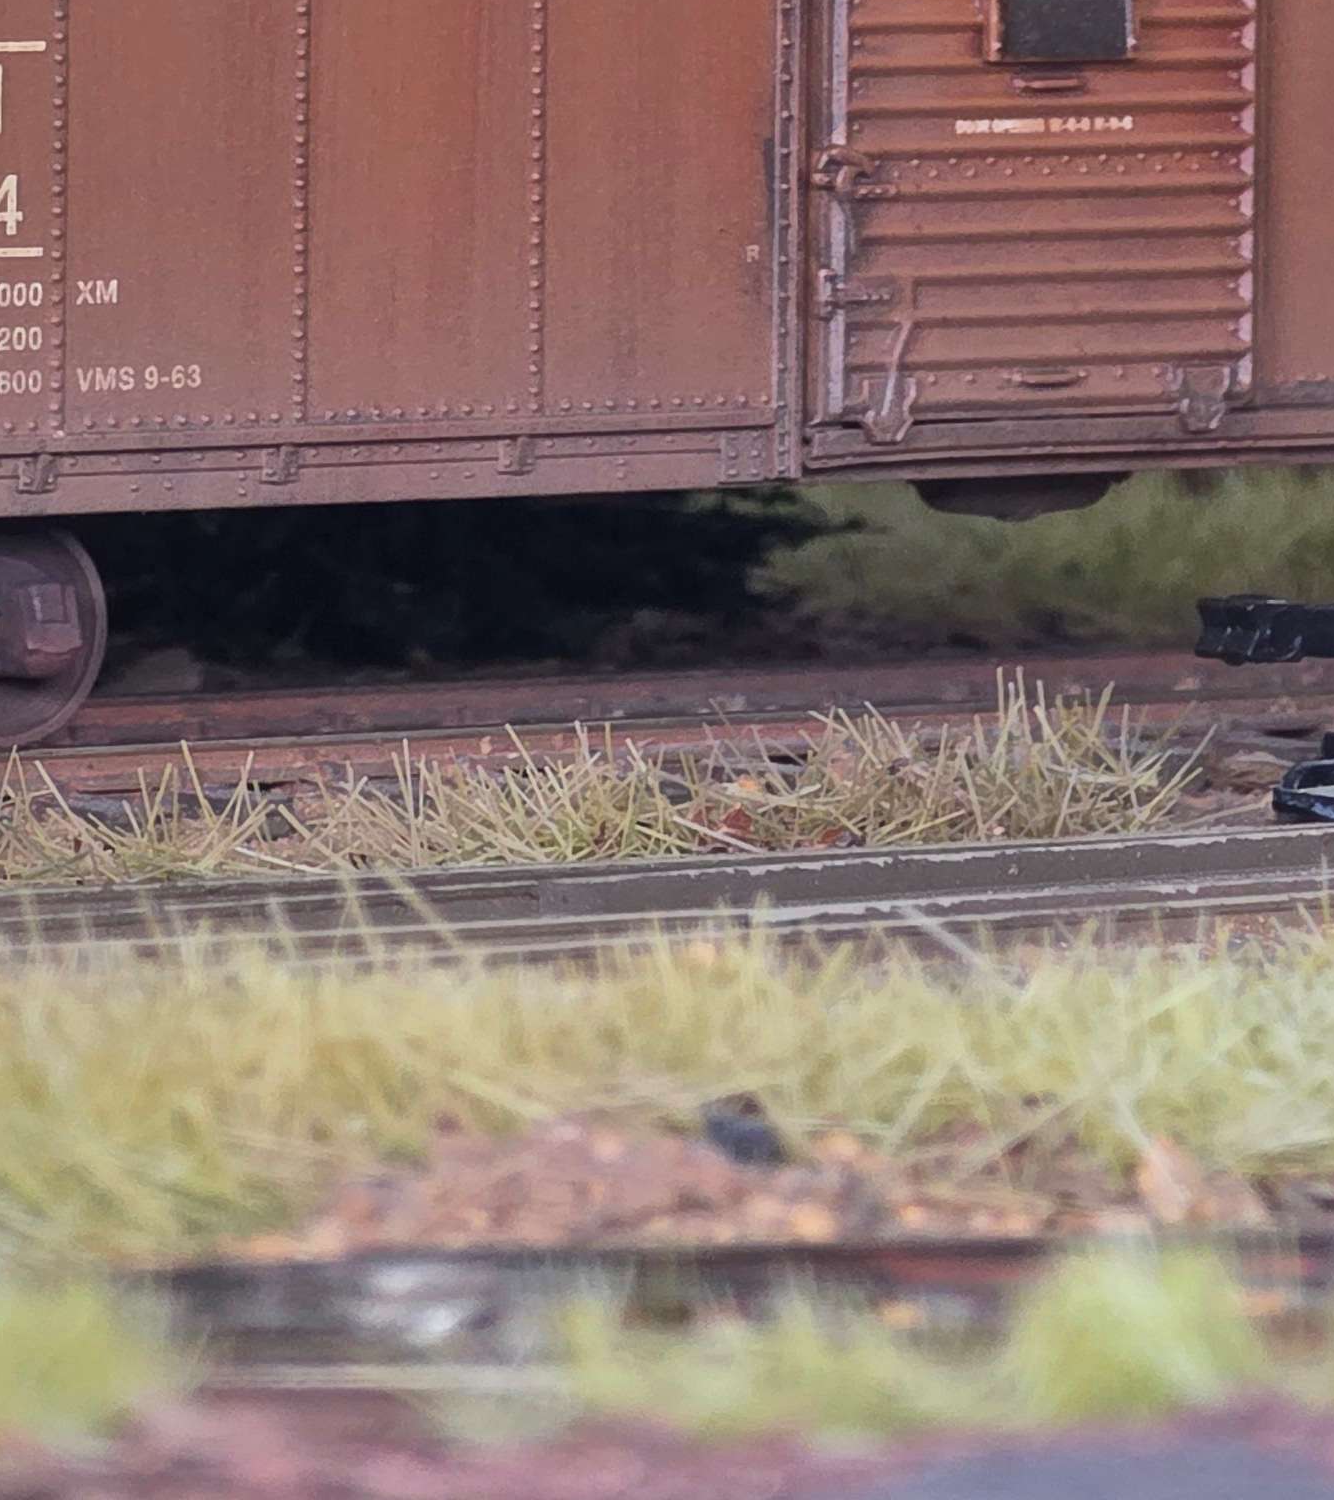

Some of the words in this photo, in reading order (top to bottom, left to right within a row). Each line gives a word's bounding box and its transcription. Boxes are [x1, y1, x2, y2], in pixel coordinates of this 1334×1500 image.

[76, 279, 118, 305] XM
[76, 366, 135, 392] VMS
[144, 364, 202, 390] 9-63
